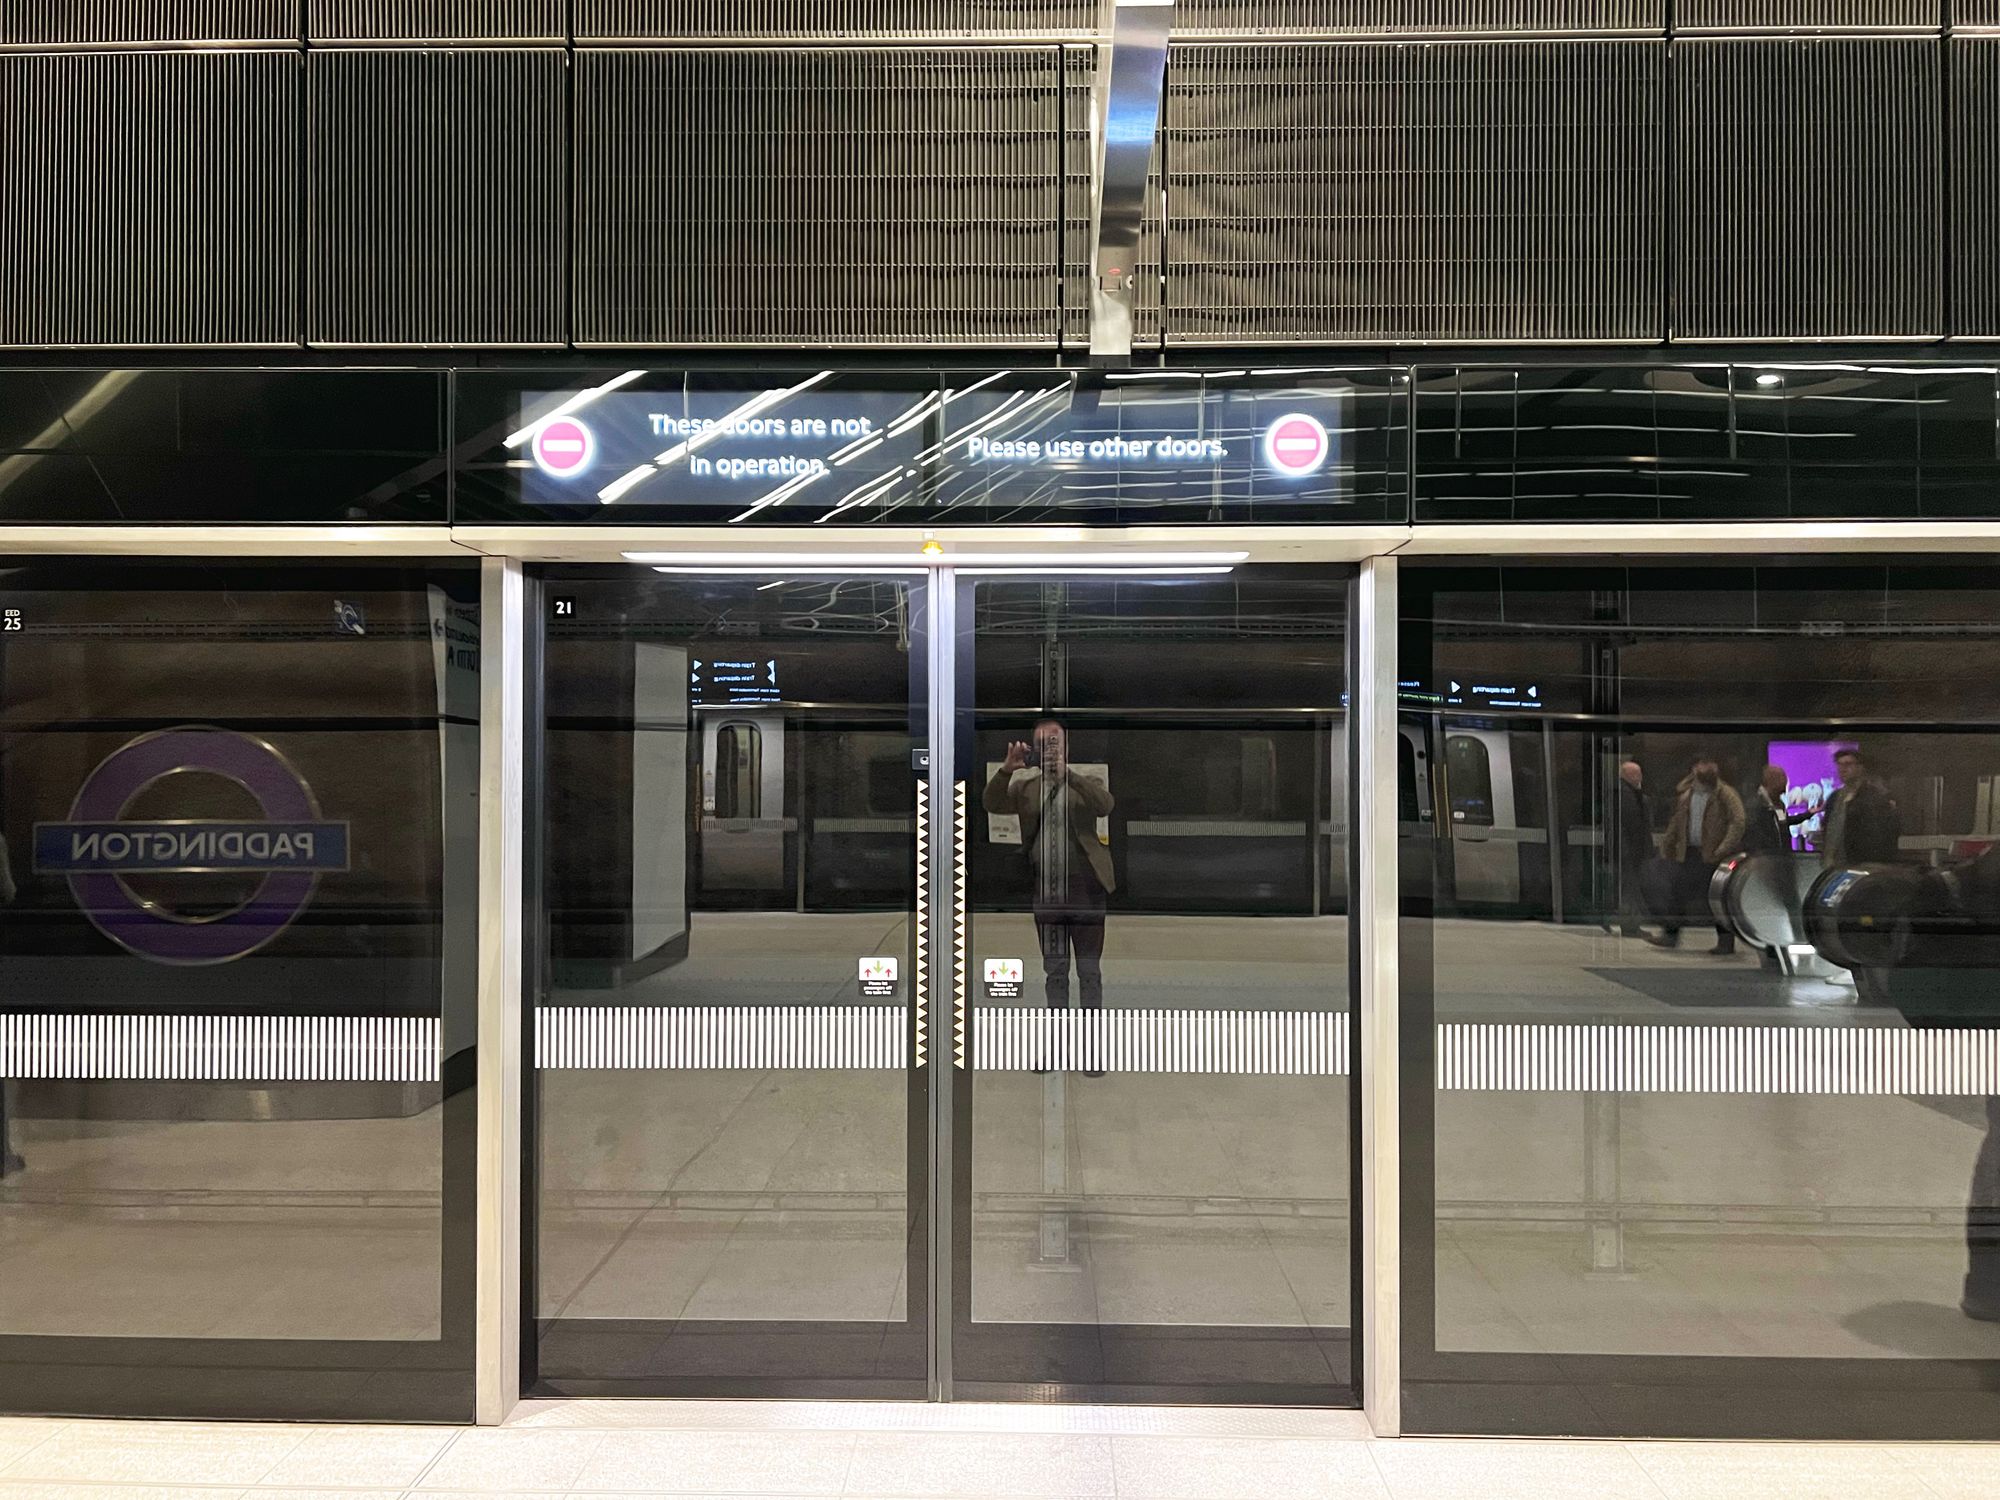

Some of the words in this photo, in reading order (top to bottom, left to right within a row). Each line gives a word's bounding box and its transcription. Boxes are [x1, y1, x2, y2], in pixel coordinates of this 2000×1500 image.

[649, 414, 714, 435] These
[722, 415, 785, 435] doors
[790, 419, 826, 435] are
[831, 416, 872, 435] not
[968, 437, 1040, 457] Please
[1046, 441, 1085, 457] use
[1089, 436, 1152, 457] other
[1157, 436, 1228, 457] doors.
[690, 455, 711, 474] in
[716, 455, 830, 479] operation.
[5, 609, 20, 617] EED
[555, 601, 572, 614] 21
[4, 617, 21, 631] 25
